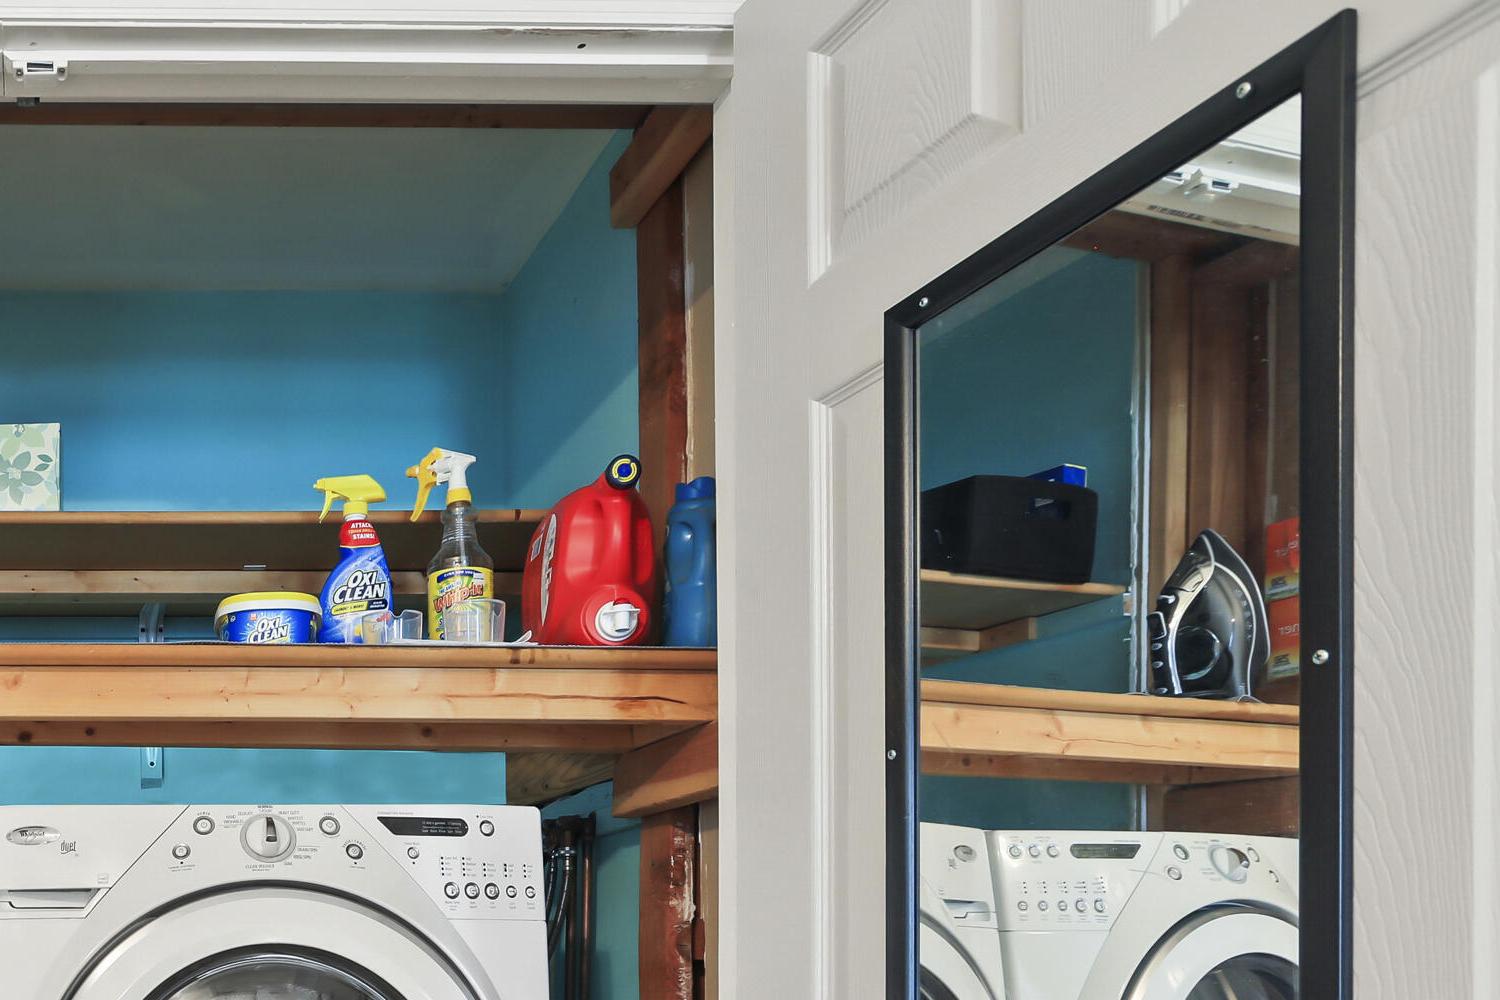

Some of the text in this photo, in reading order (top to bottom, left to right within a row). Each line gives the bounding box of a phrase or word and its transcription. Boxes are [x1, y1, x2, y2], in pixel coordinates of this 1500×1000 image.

[347, 569, 378, 588] OXI
[333, 582, 387, 604] CLEAN
[257, 617, 281, 631] OXI
[248, 625, 288, 643] CLEAN
[60, 839, 77, 854] duet
